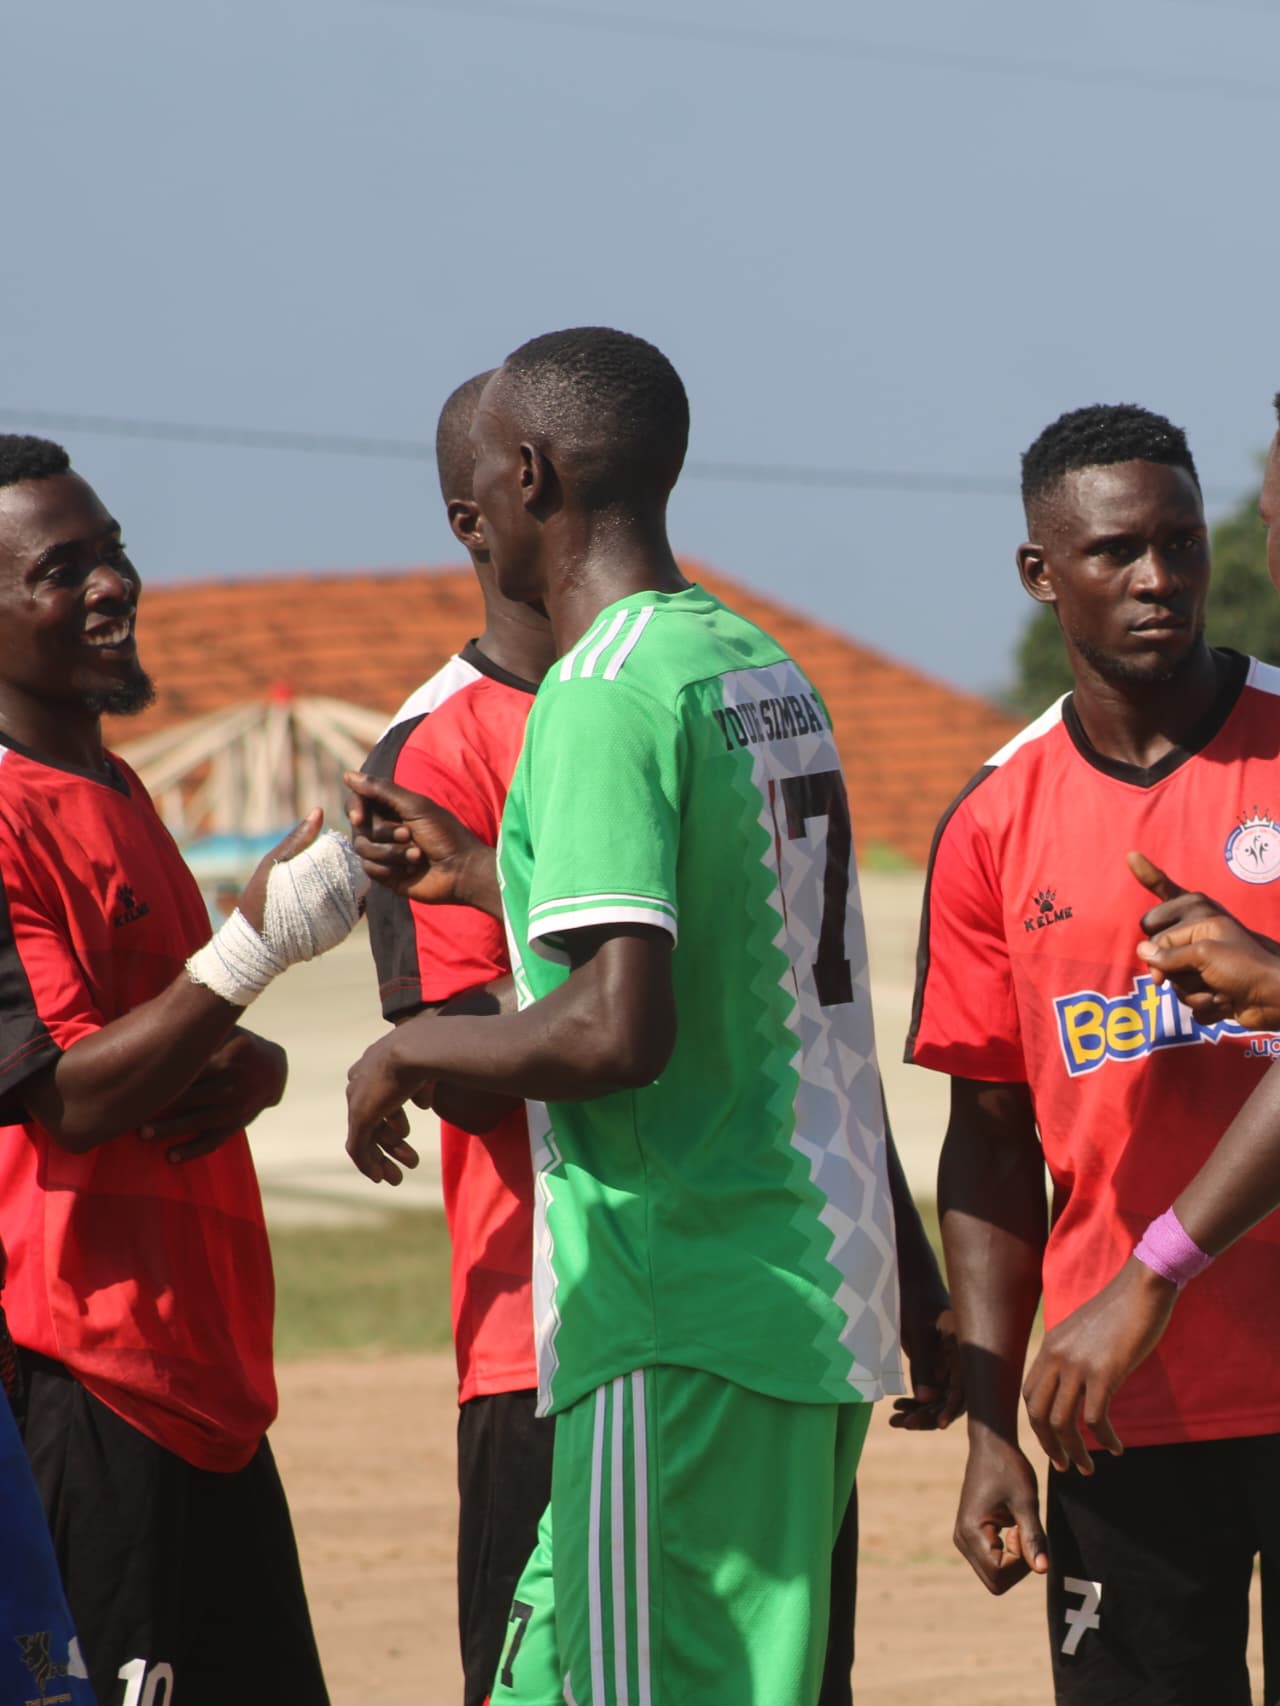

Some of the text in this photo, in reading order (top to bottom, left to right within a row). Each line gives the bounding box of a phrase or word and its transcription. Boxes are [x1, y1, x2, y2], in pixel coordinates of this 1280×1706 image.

[1023, 906, 1073, 933] KELME
[501, 1599, 534, 1689] 7
[1061, 1576, 1102, 1656] 7
[117, 1657, 174, 1706] 10
